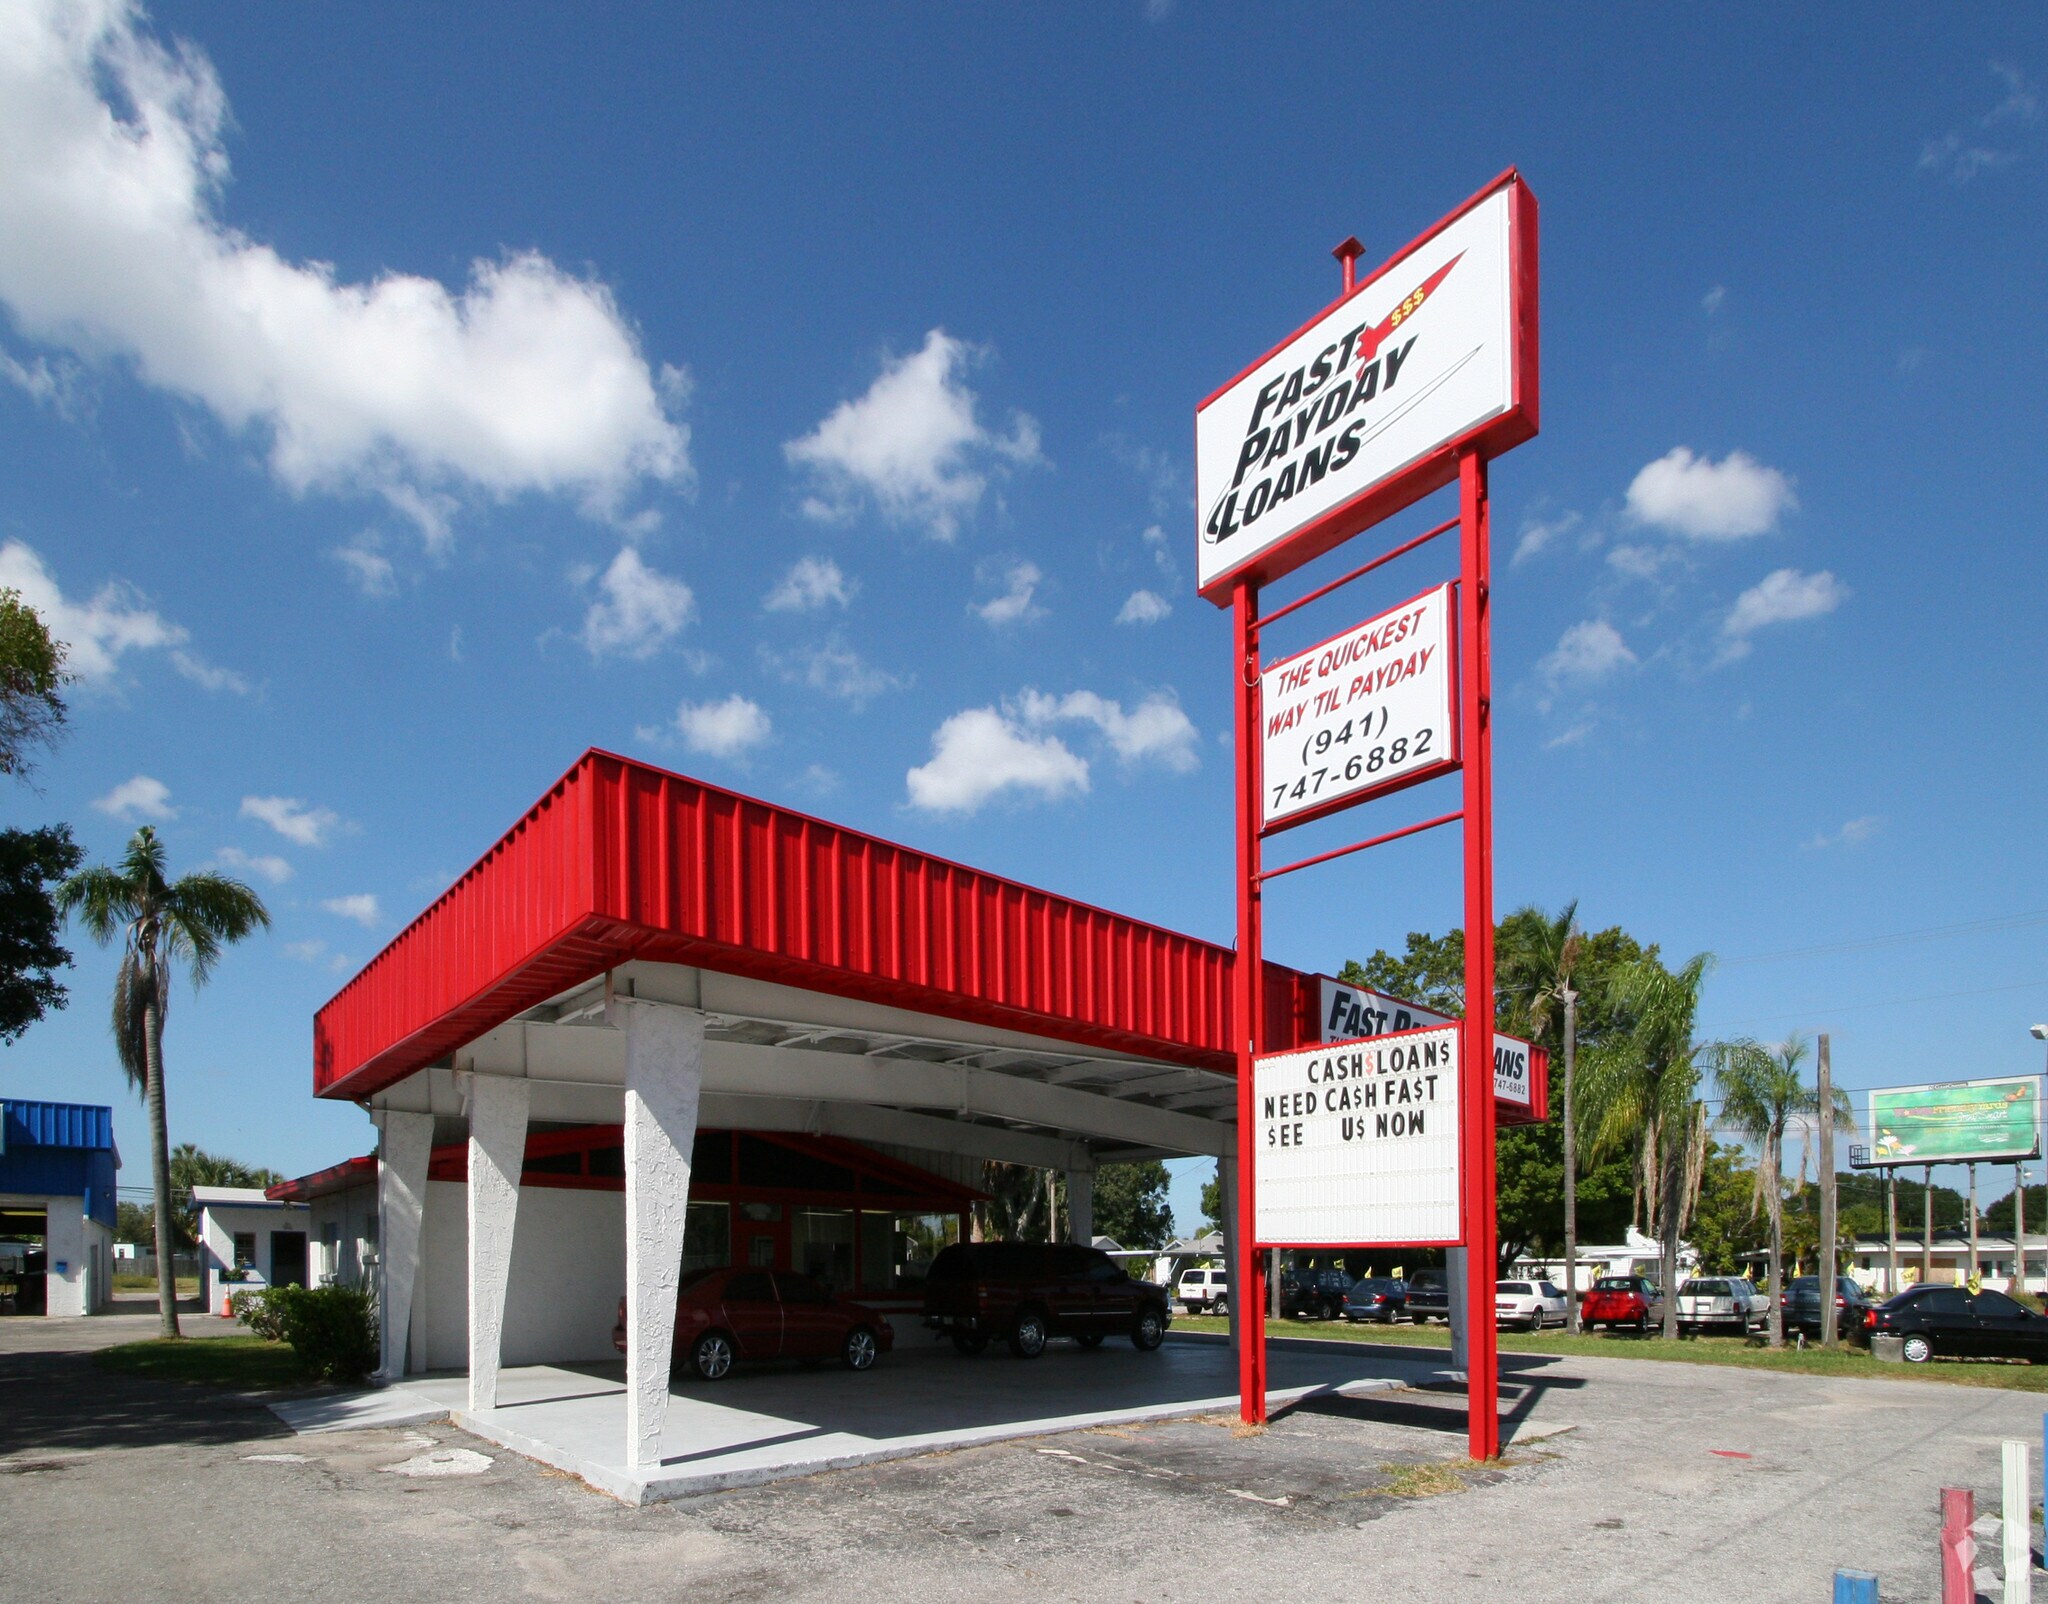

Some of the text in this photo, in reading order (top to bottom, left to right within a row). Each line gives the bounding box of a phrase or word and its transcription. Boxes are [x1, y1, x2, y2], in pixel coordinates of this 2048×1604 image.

[1231, 333, 1420, 490] PAYDAY
[1246, 320, 1368, 438] FAST
[1208, 418, 1366, 545] LOANS
[1267, 699, 1309, 739] WAY
[1347, 643, 1436, 704] PAYDAY
[1277, 606, 1427, 697] THE QUICKEST
[1272, 728, 1433, 809] 747-6882
[1302, 705, 1388, 766] (941)
[1328, 990, 1388, 1038] FAST
[1264, 1091, 1317, 1119] NEED
[1376, 1109, 1425, 1138] NOW
